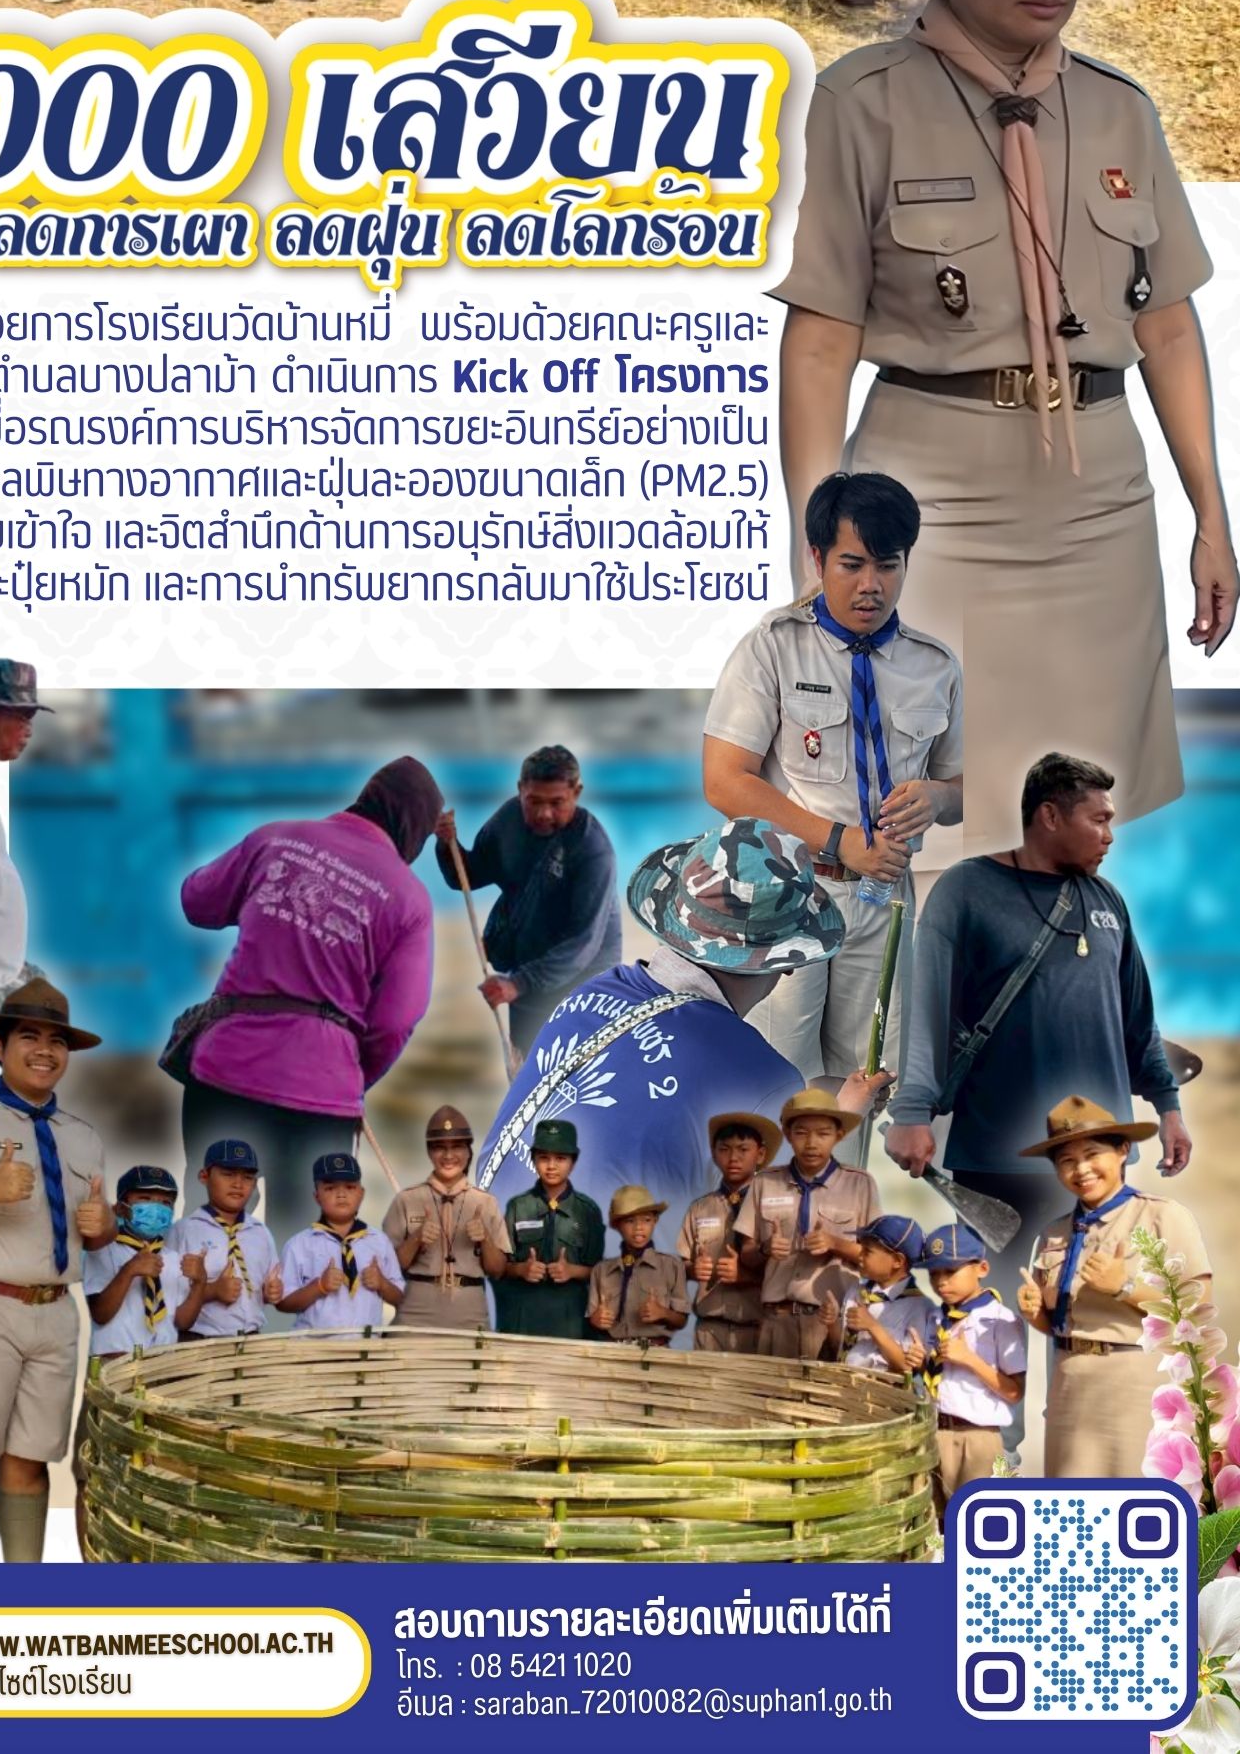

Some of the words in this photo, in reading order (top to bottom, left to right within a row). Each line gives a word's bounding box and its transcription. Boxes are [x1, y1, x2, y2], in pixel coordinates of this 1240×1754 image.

[314, 25, 757, 181] เสวียน
[274, 181, 438, 279] ลดฝุ่น
[465, 177, 758, 256] ลดโลกร้อน
[421, 300, 769, 354] พร้อมด้วยคณะครูและ
[272, 353, 438, 393] ดำเนินการ
[453, 357, 529, 393] Kick
[542, 357, 601, 393] Off
[614, 353, 769, 393] โครงการ
[640, 459, 769, 502] (PM2.5)
[105, 503, 771, 562] และจิตสำนึกด้านการอนุรักษ์สิ่งแวดล้อมให้
[145, 561, 771, 601] และการนำทรัพยากรกลับมาใช้ประโยชน์
[648, 1075, 679, 1100] 2
[394, 1583, 891, 1639] สอบถามรายละเอียดเพิ่มเติมได้ที่
[396, 1648, 444, 1679] โทร.
[470, 1653, 502, 1678] 08
[510, 1652, 567, 1678] 5421
[573, 1651, 632, 1677] 1020
[396, 1686, 454, 1717] อีเมล
[473, 1686, 893, 1720] saraban_72010082@suphan1.go.th
